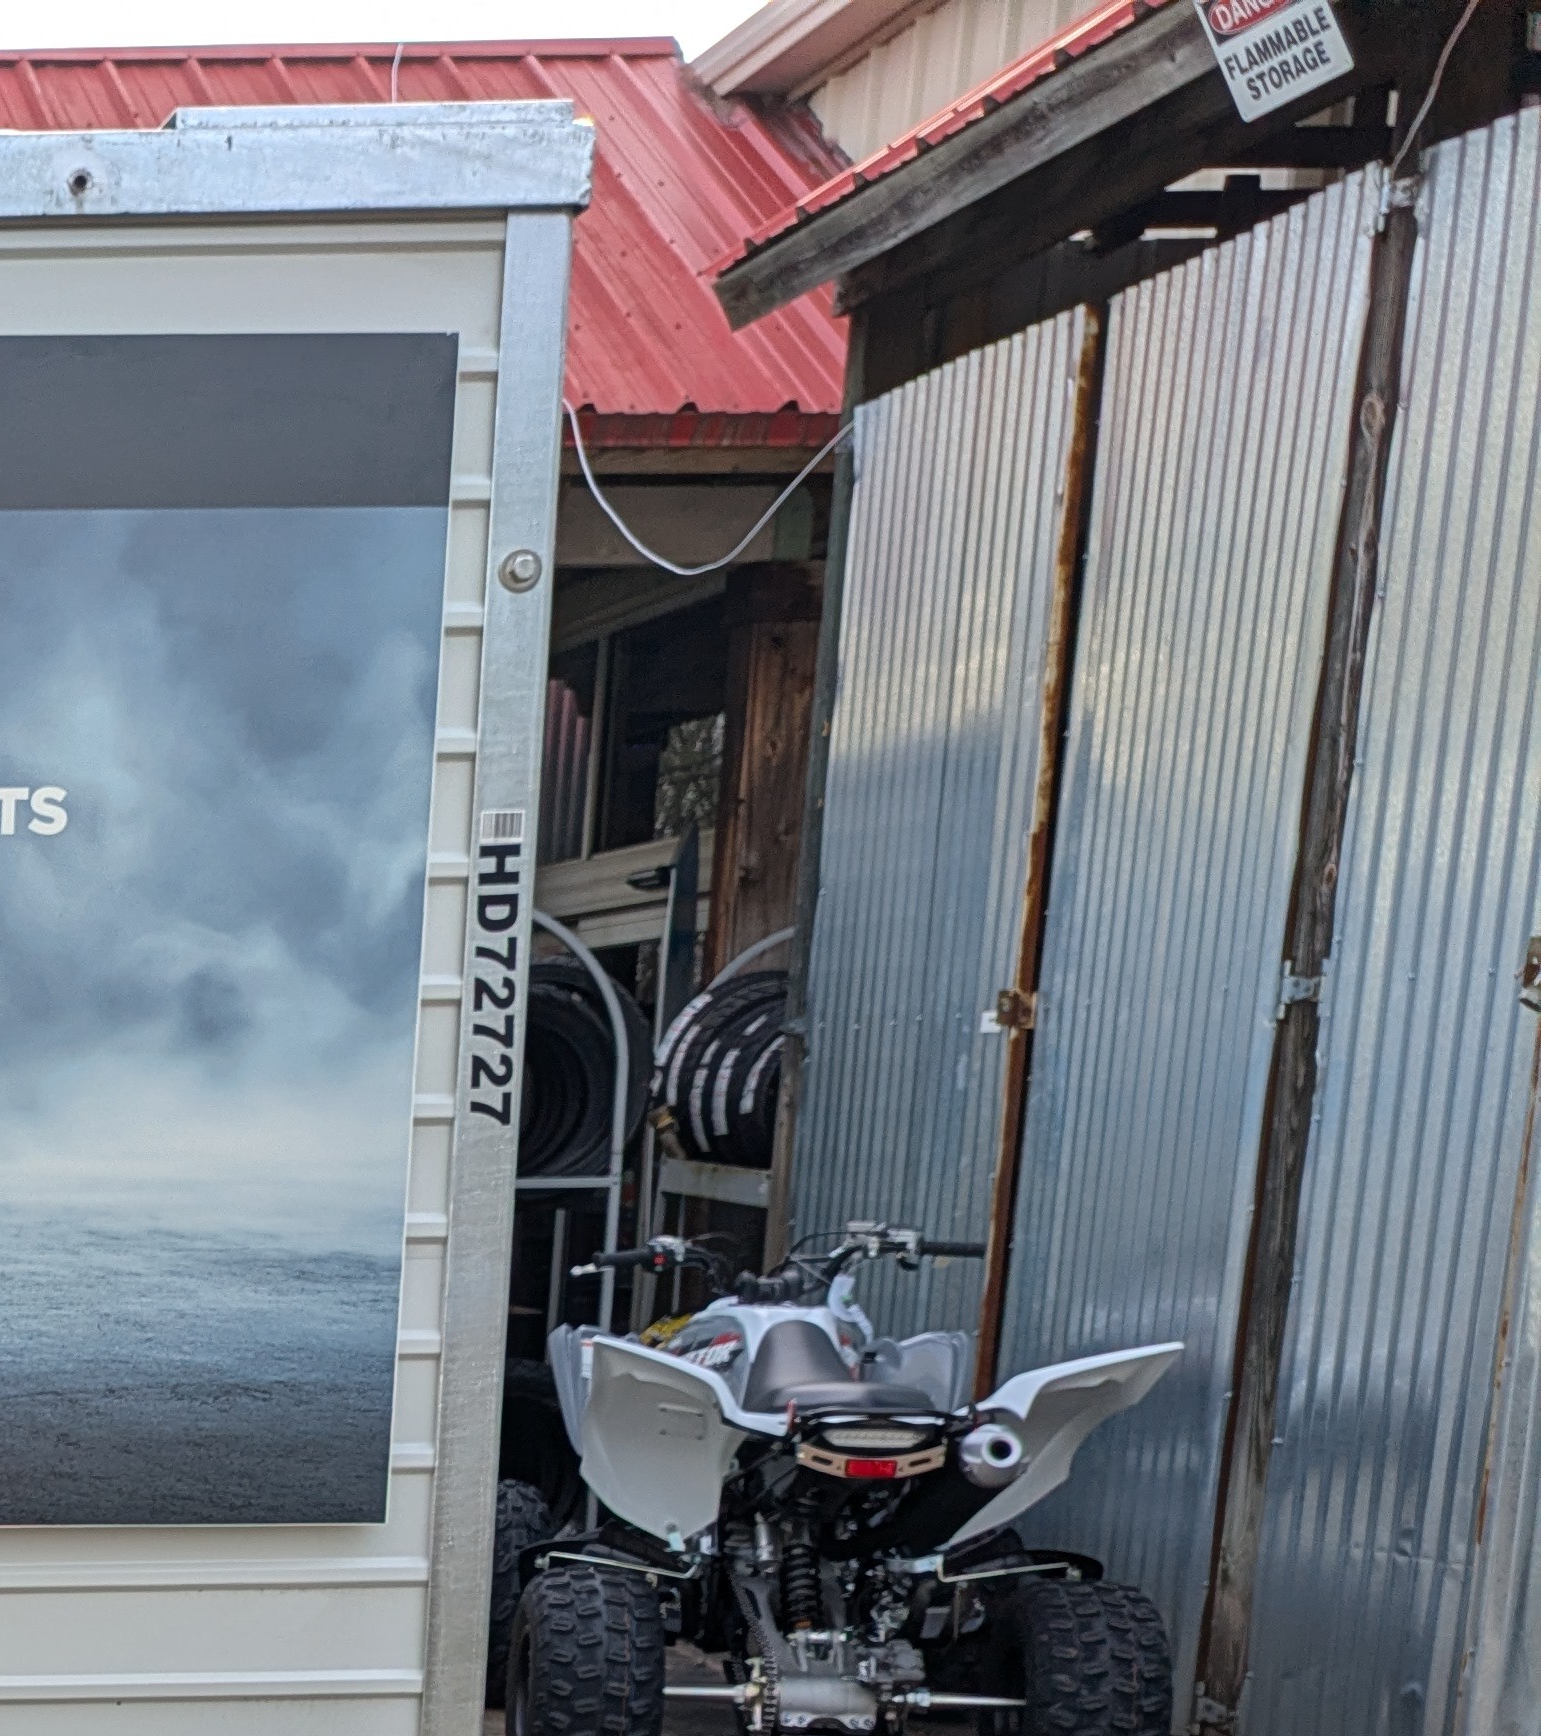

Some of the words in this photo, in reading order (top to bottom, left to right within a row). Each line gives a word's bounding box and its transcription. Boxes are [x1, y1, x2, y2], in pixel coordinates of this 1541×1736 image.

[1223, 7, 1331, 81] FLAMMABLE
[1246, 40, 1331, 101] STORAGE
[470, 844, 521, 1125] HD72727
